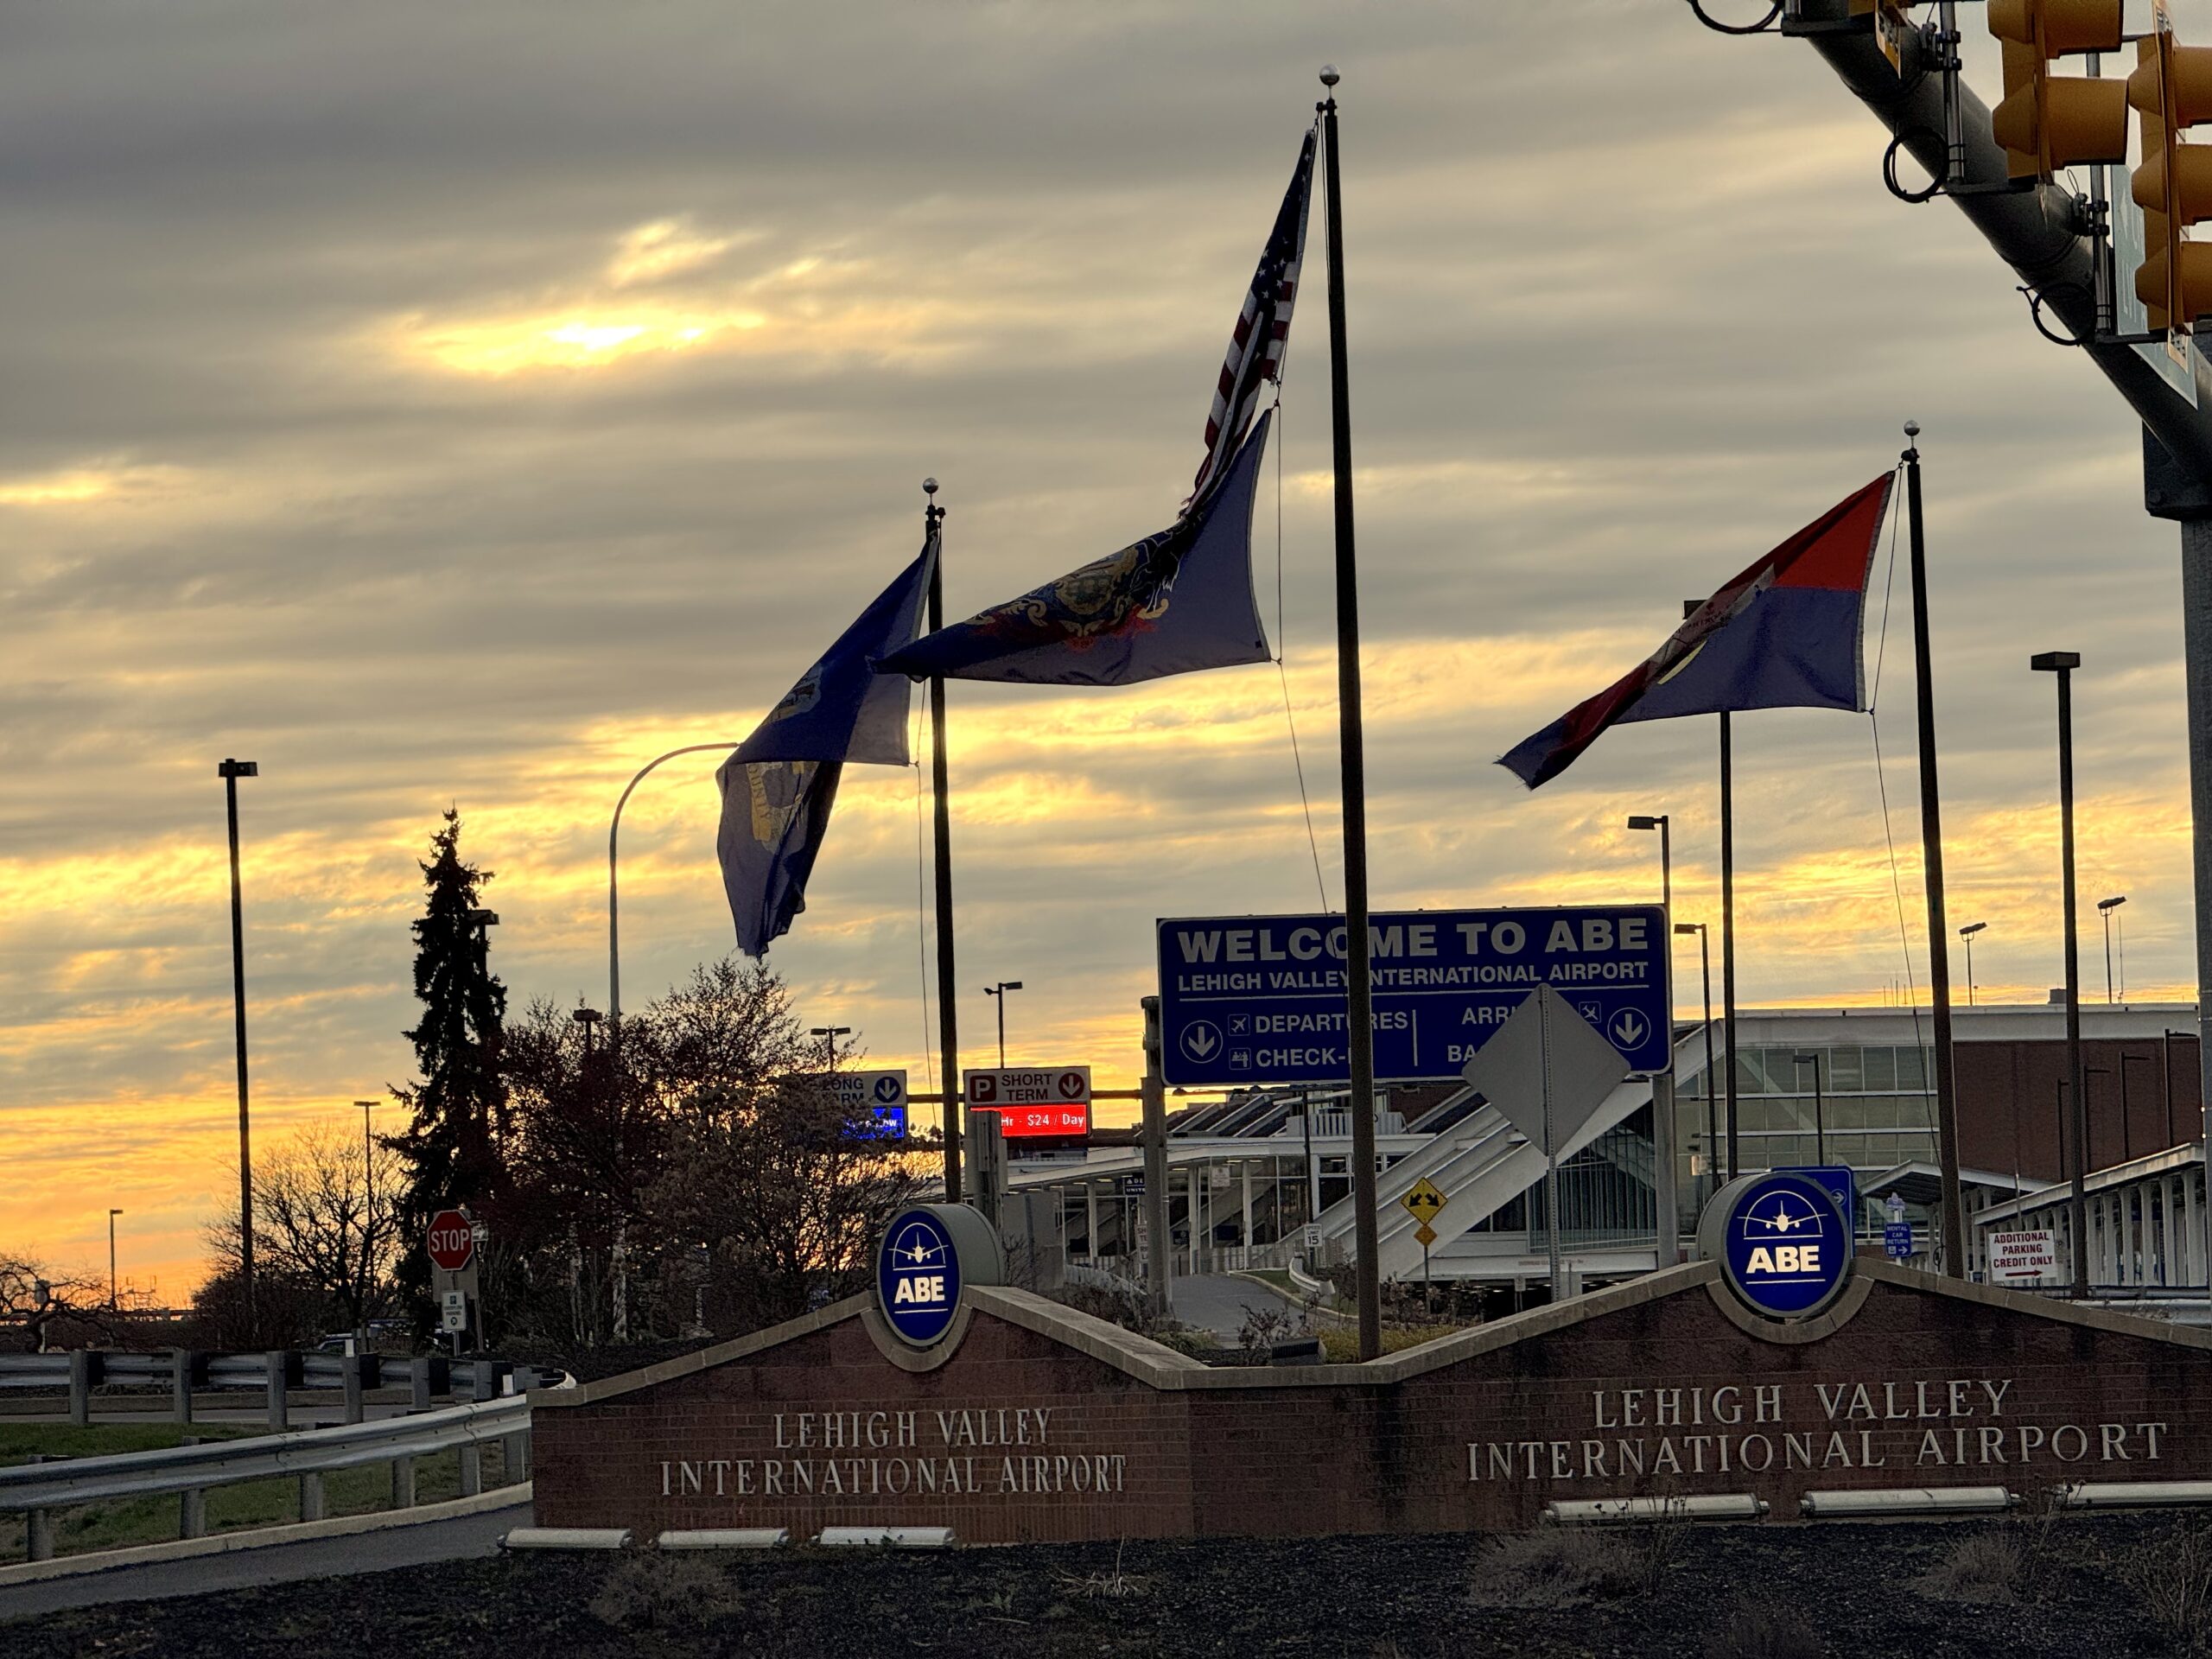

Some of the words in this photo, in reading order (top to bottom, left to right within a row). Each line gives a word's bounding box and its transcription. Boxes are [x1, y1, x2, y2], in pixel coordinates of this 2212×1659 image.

[1177, 925, 1438, 963] WELCOME
[1456, 921, 1526, 955] TO
[1544, 918, 1649, 953] ABE
[1178, 973, 1262, 992] LEHIGH
[1369, 965, 1541, 987] NTERNATIONAL
[1548, 962, 1649, 982] AIRPORT
[1255, 1011, 1408, 1033] DEPARTRES
[1255, 1047, 1352, 1068] CHECK-I
[1001, 1073, 1052, 1086] SHORT
[1007, 1089, 1048, 1102] TERM
[1027, 1114, 1050, 1127] $24
[1062, 1114, 1084, 1128] Day
[431, 1229, 470, 1252] STOP
[1308, 1236, 1319, 1244] 15
[1994, 1232, 2050, 1244] ADDITIONAL
[1746, 1245, 1821, 1274] ABE
[2002, 1244, 2043, 1255] PARKING
[1993, 1257, 2027, 1268] CREDIT
[2031, 1255, 2053, 1266] ONLY
[894, 1275, 945, 1304] ABE
[1592, 1384, 1783, 1429] LEHIGH
[1813, 1379, 2012, 1421] VALLEY
[773, 1411, 918, 1449] LEHIGH
[936, 1408, 1052, 1447] VALLEY
[1466, 1430, 1886, 1481] INTERNATIONAL
[1914, 1422, 2167, 1466] AIRPORT
[660, 1458, 982, 1496] INTERNATIONAL
[999, 1454, 1127, 1494] AIRPORT
